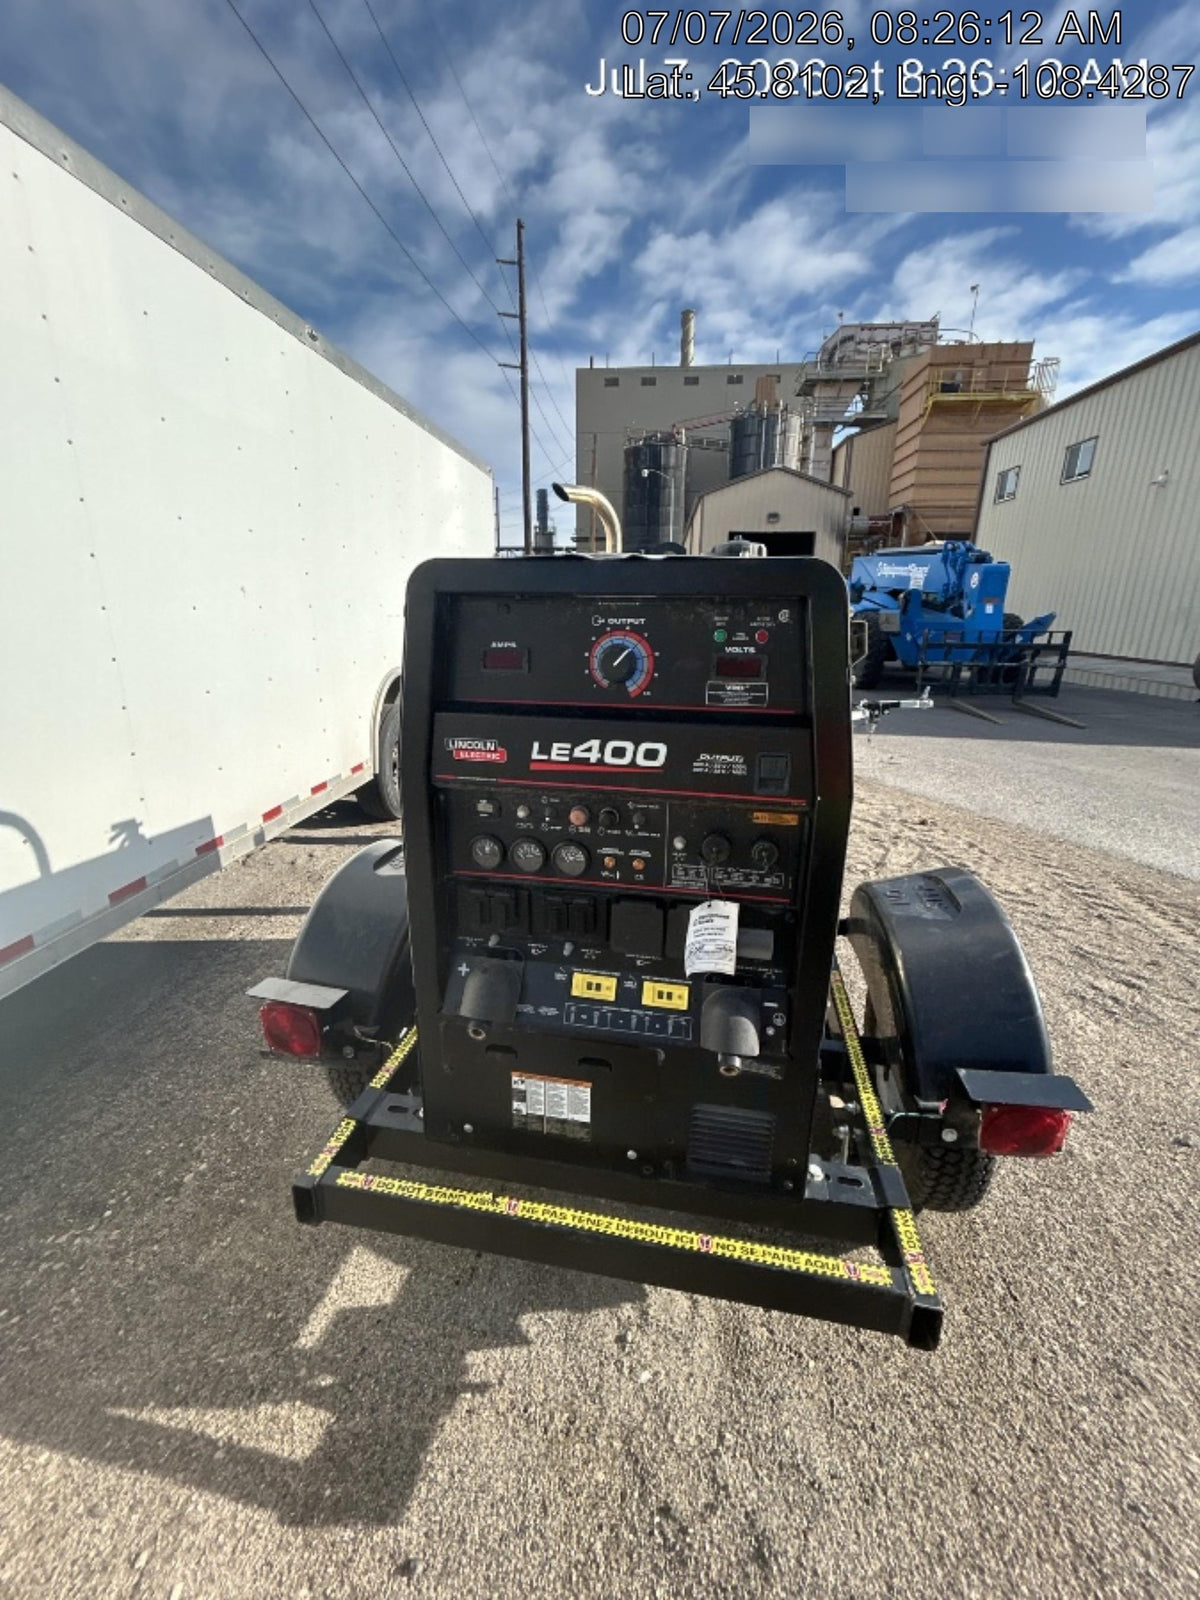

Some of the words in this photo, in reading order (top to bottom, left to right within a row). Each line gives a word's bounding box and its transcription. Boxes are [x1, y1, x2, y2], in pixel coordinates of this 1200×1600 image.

[724, 646, 757, 654] VOLTS
[449, 739, 496, 751] LINCOLN
[531, 739, 667, 767] LE400
[459, 751, 501, 760] ELECTRIC
[376, 1181, 395, 1190] DO
[397, 1184, 421, 1194] NOT
[425, 1188, 467, 1201] STAND
[542, 1209, 568, 1220] PAS
[570, 1214, 613, 1230] TENEZ
[715, 1241, 737, 1252] NO
[761, 1249, 801, 1264] PARE
